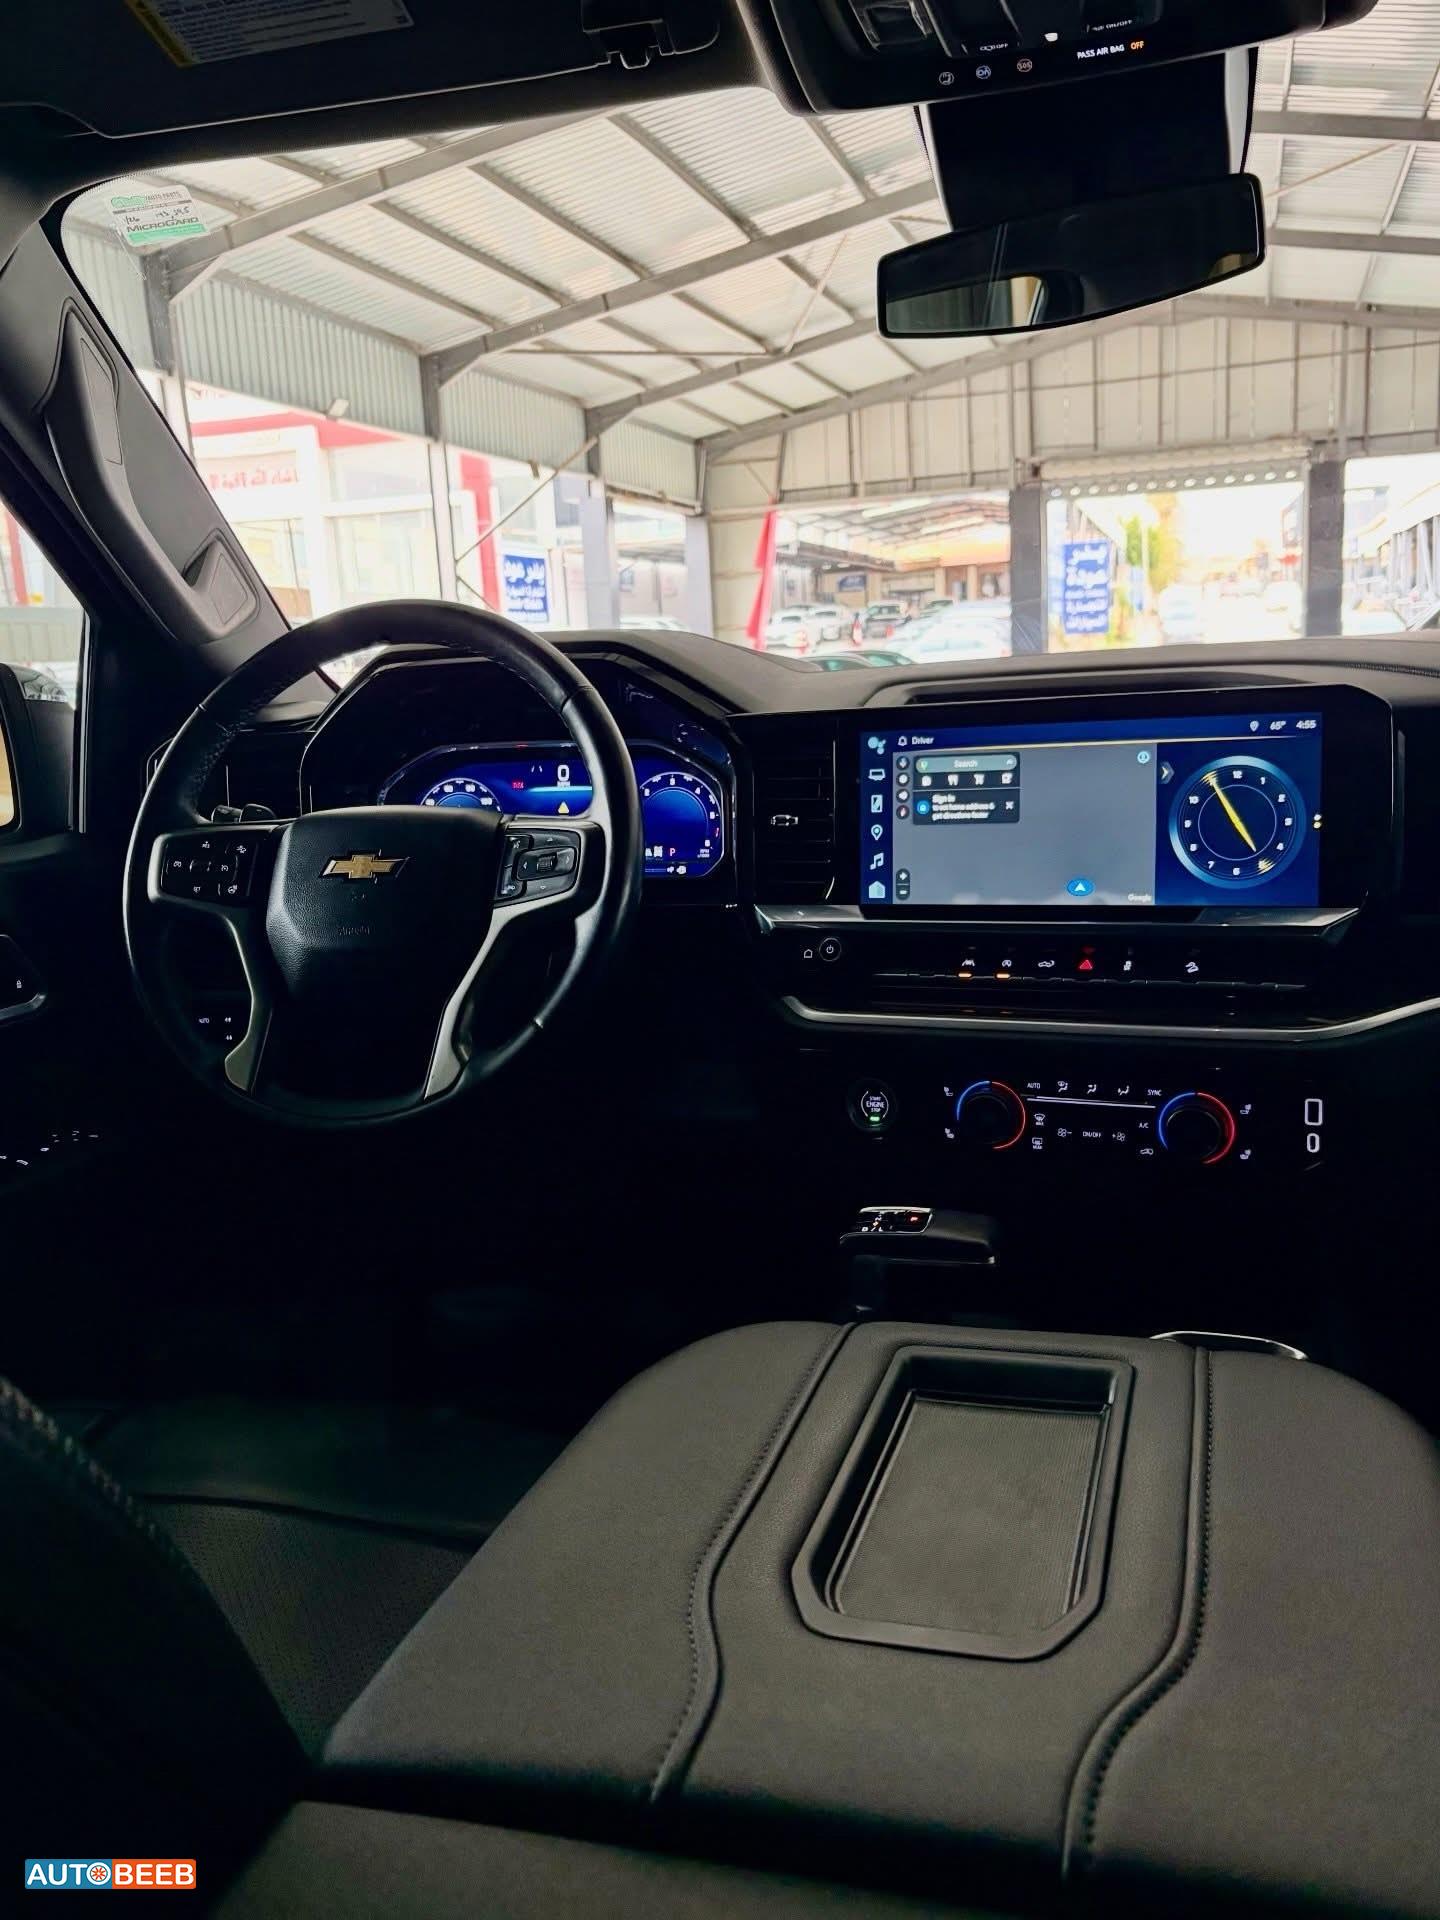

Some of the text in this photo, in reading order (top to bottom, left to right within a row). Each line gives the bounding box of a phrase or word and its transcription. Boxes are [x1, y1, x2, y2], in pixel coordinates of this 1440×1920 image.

[1077, 41, 1144, 59] PASS AIR BAG OFF
[1295, 719, 1317, 730] 4:55
[911, 736, 935, 745] Driver
[953, 759, 978, 768] Search
[557, 763, 570, 782] 0
[669, 847, 676, 857] P
[1026, 1082, 1041, 1090] AUTO
